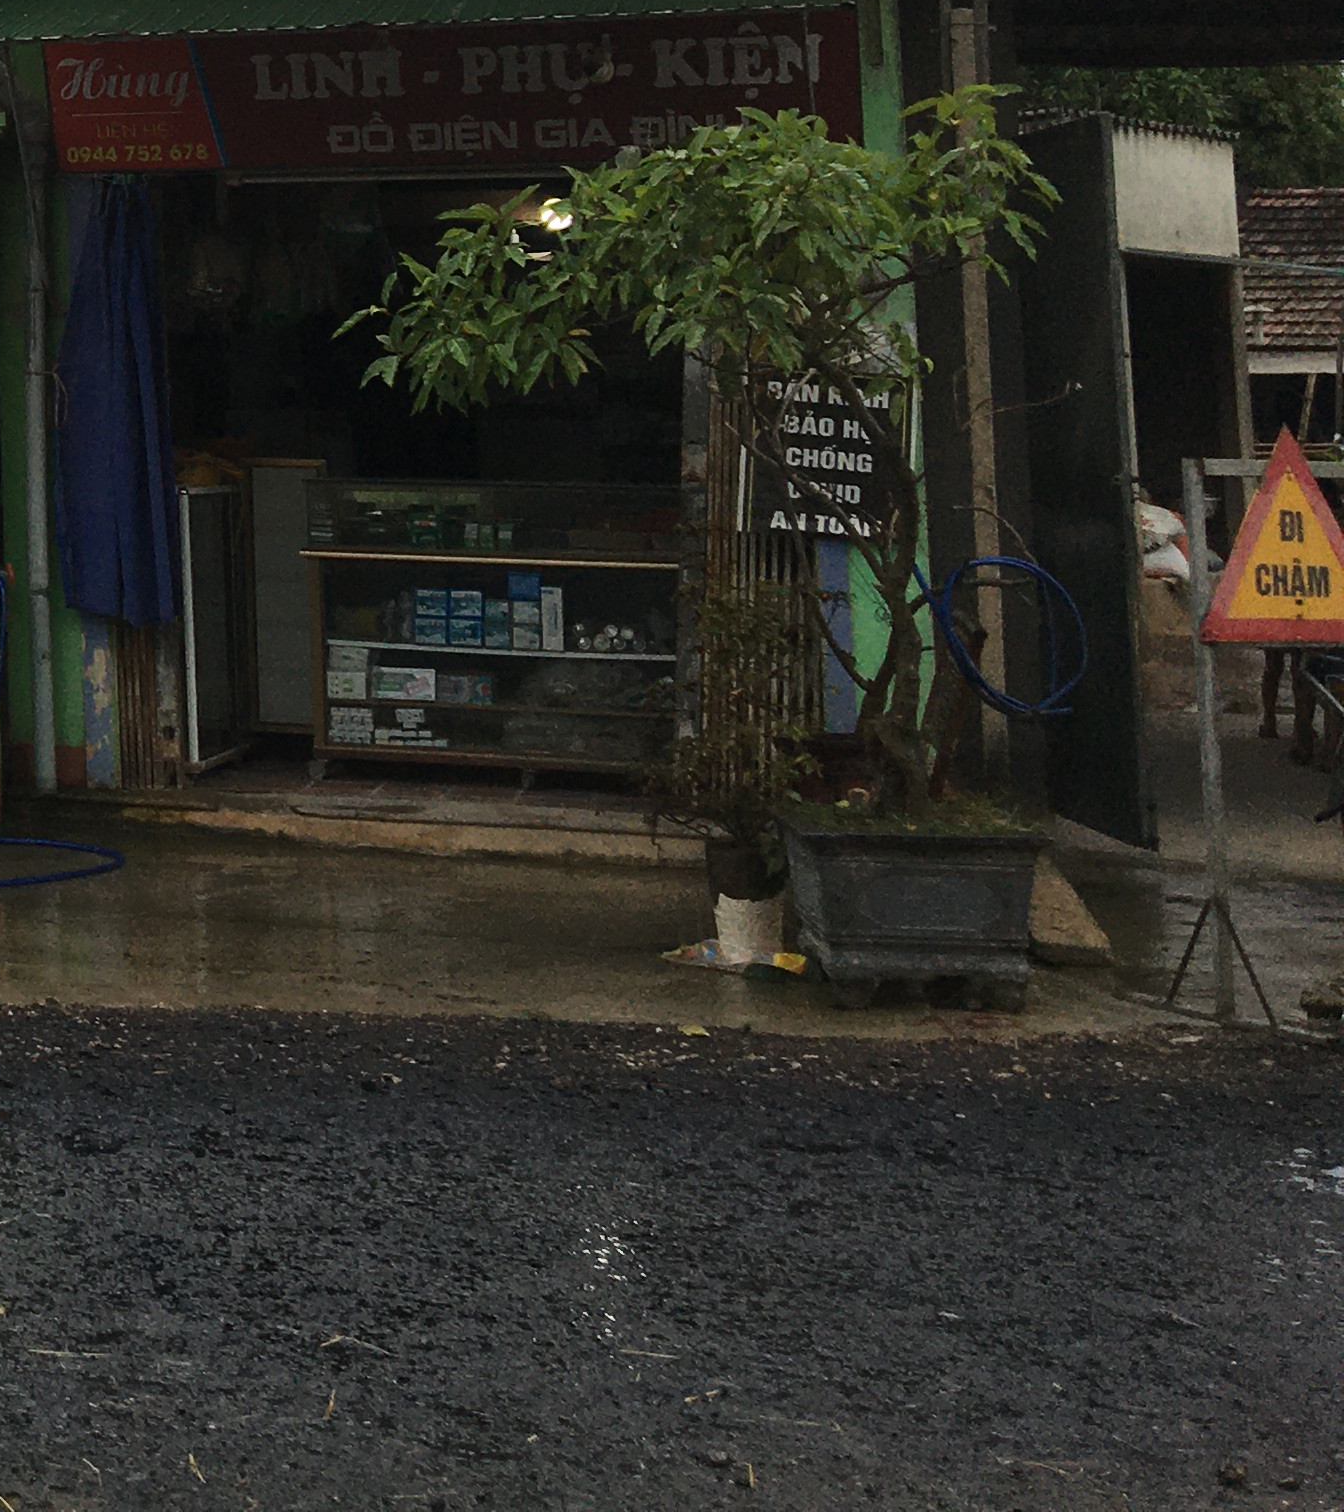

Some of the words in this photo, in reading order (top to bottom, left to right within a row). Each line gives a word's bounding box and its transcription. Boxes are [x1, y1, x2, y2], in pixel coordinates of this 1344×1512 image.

[55, 55, 190, 107] Hùng
[248, 46, 404, 102] LINH
[652, 22, 825, 102] KIỆN
[65, 145, 118, 164] 0944
[124, 144, 163, 163] 752
[168, 142, 210, 161] 678
[326, 110, 395, 153] ĐỒ
[407, 113, 519, 158] ĐIỆN
[534, 118, 616, 149] GIA
[785, 444, 874, 474] CHỐNG
[1278, 508, 1304, 544] ĐI
[1254, 561, 1331, 606] CHẬM
